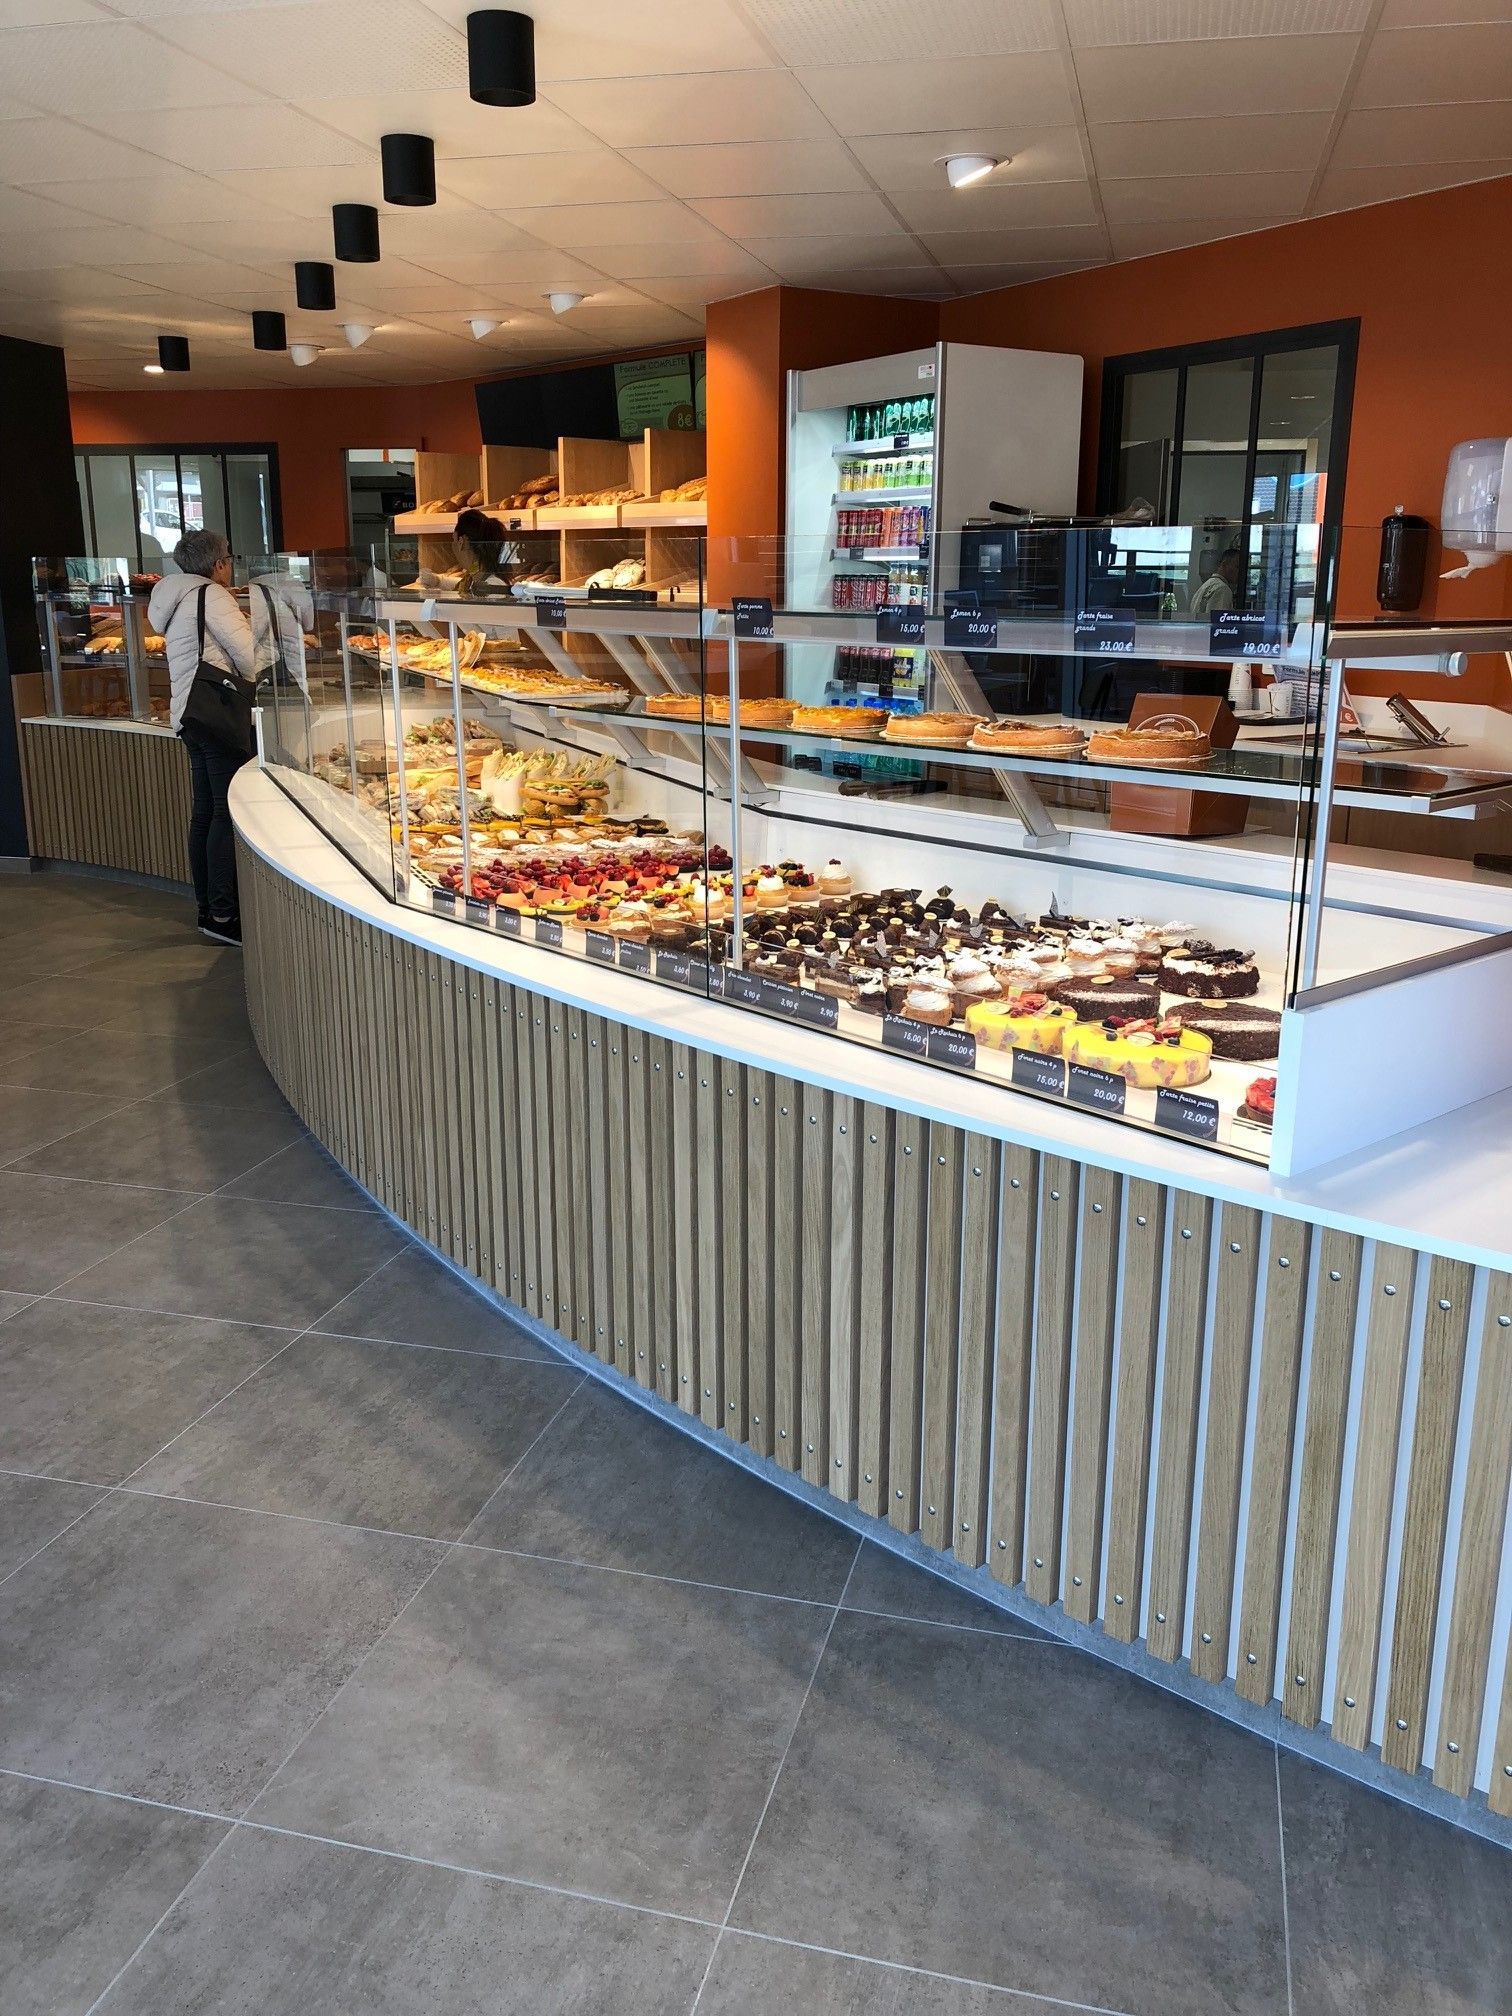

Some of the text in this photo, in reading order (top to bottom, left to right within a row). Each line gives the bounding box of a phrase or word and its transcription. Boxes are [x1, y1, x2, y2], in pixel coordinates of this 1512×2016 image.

[877, 605, 895, 615] Lemon
[950, 608, 971, 619] Lemon
[976, 611, 982, 619] p
[1077, 611, 1113, 622] Tarte fraise
[1219, 612, 1266, 622] Tarte abricot
[753, 626, 769, 635] 10,00
[900, 623, 925, 634] 15,00 €
[967, 623, 997, 634] 20,00 €
[1074, 623, 1096, 634] grande
[1213, 627, 1239, 637] grande
[1100, 640, 1133, 652] 23,00 €
[1242, 642, 1280, 655] 19,00 €
[903, 1031, 922, 1043] 15,00
[948, 1043, 968, 1055] 20,00
[1036, 1074, 1065, 1089] 15,00 €
[1093, 1088, 1125, 1105] 20,00 €
[1159, 1089, 1216, 1109] Tarte fraise petite
[1182, 1109, 1216, 1127] 12,00 €
